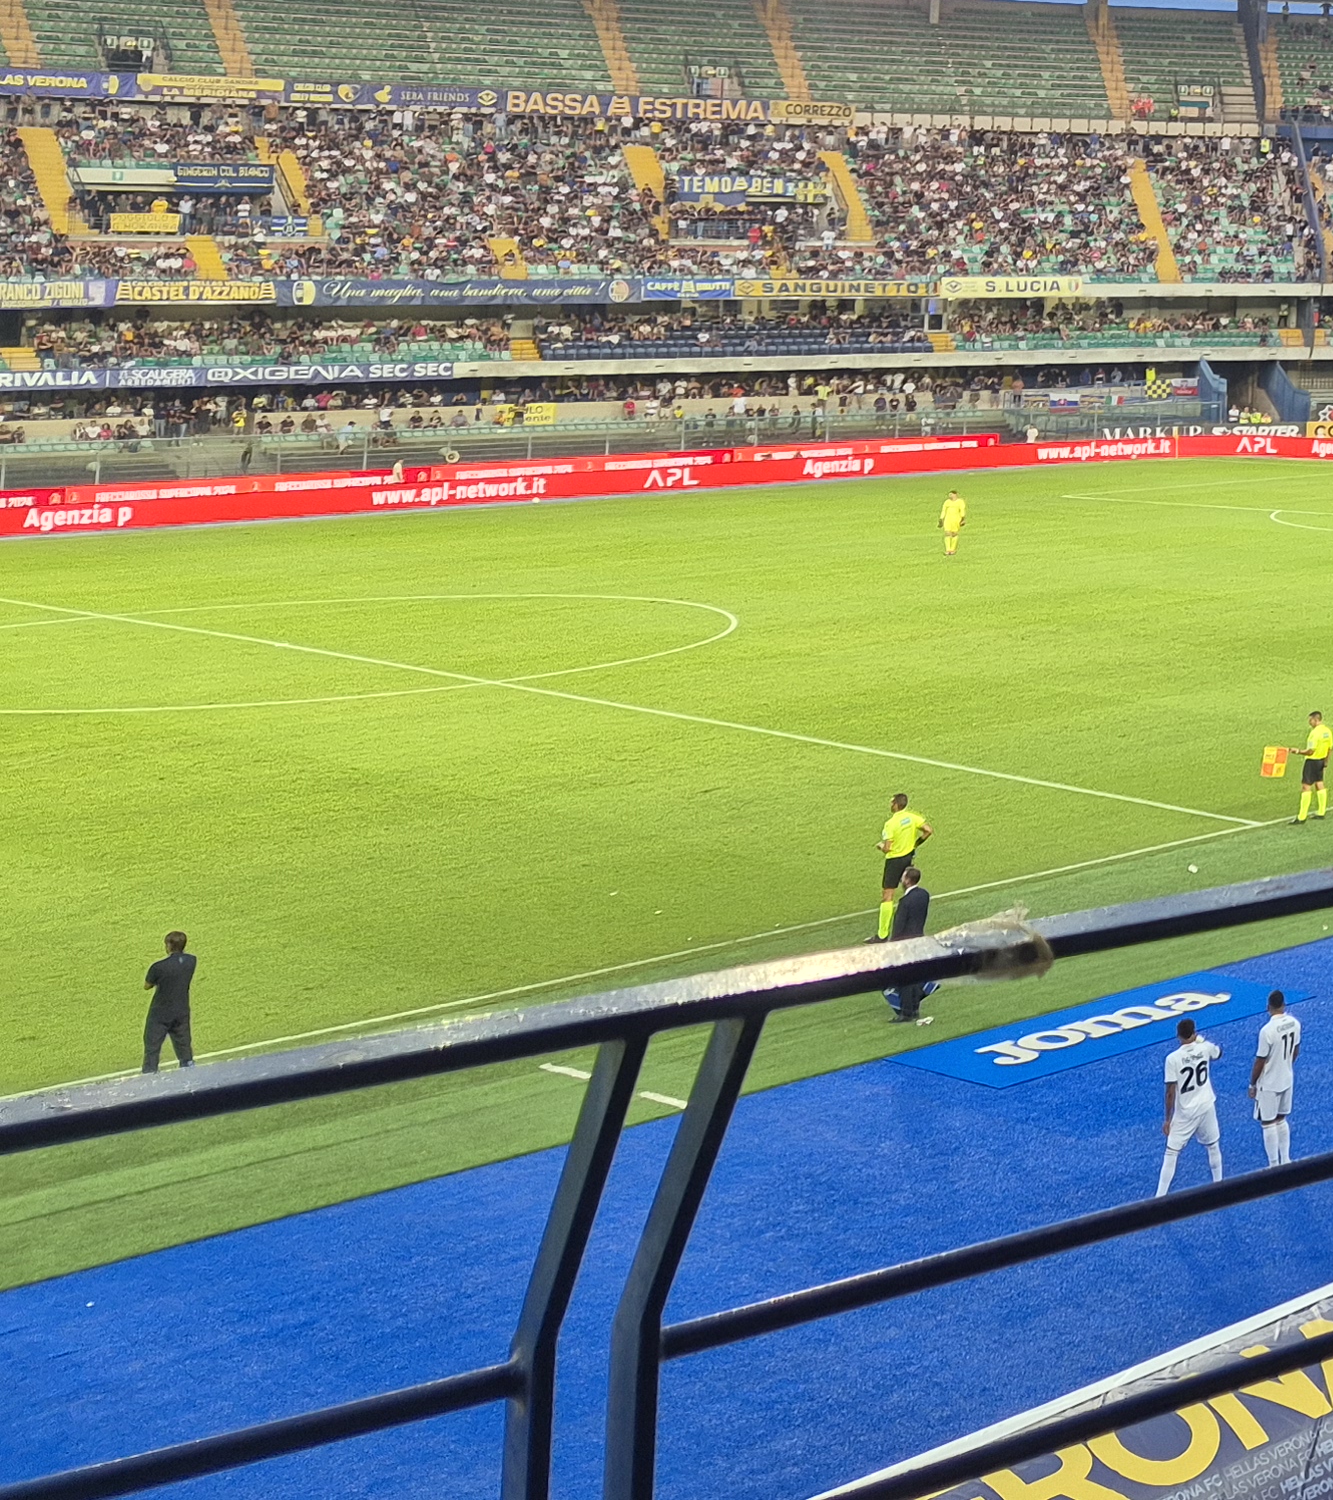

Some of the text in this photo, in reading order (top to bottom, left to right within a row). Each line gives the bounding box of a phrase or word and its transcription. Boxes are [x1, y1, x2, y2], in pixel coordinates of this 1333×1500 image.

[27, 76, 87, 88] VERONA
[163, 87, 256, 98] LA MERIDIANA
[428, 91, 470, 102] FRIENDS
[506, 90, 765, 121] BASSA ESTREMA
[785, 104, 851, 117] CORREZZO
[44, 282, 84, 300] ZIGONI
[133, 286, 260, 300] CASTEL D'AZZANO
[762, 281, 919, 295] SANGUINETTO
[369, 364, 410, 379] SEC
[414, 362, 452, 377] SEC
[1037, 439, 1171, 461] www.apl-network.it
[1235, 436, 1278, 454] APL
[643, 467, 701, 489] APL
[802, 457, 875, 478] Agenzia p
[371, 477, 547, 506] www.apl-network.it
[23, 503, 133, 531] Agenzia p
[973, 991, 1232, 1066] Joma
[1281, 1031, 1295, 1061] 11
[1180, 1060, 1208, 1094] 26
[1226, 1451, 1267, 1483] HELLAS
[1249, 1455, 1295, 1490] VERONA
[1281, 1462, 1322, 1495] HELLAS
